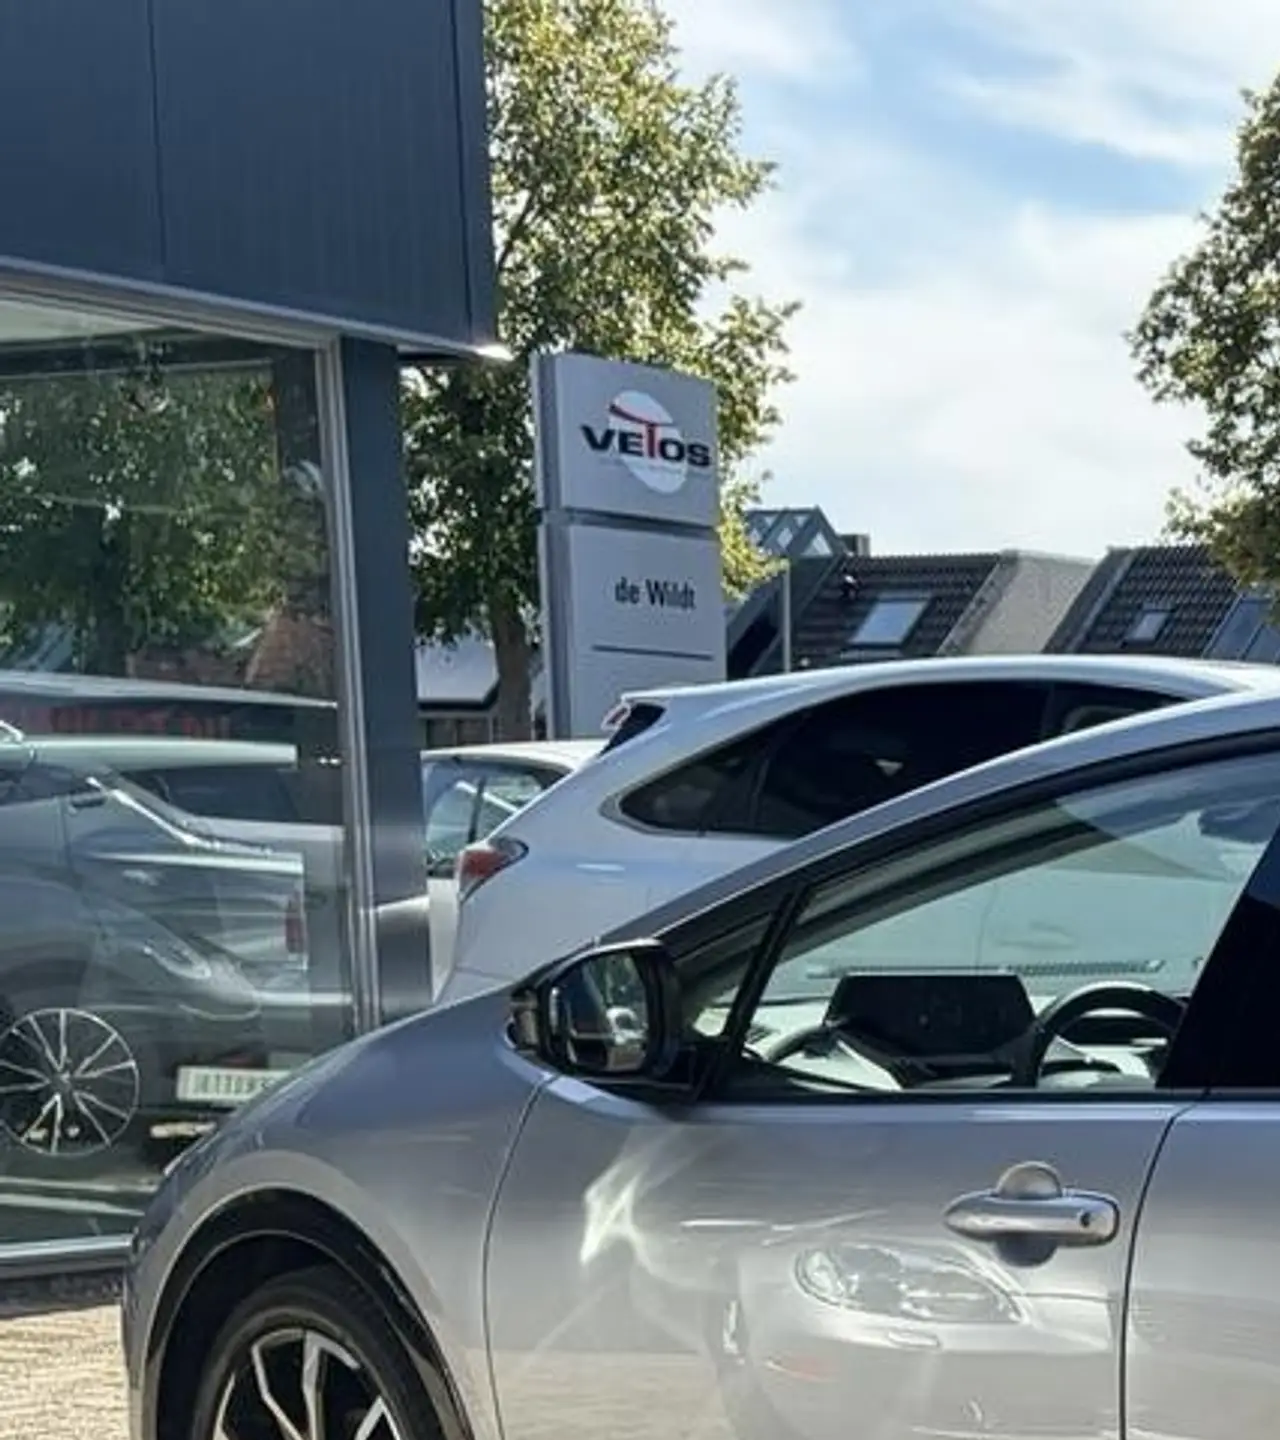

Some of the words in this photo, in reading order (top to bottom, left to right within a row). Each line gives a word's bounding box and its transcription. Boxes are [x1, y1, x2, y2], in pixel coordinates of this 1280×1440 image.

[581, 419, 712, 468] VETOS
[614, 576, 641, 605] de
[645, 578, 697, 611] Wildt
